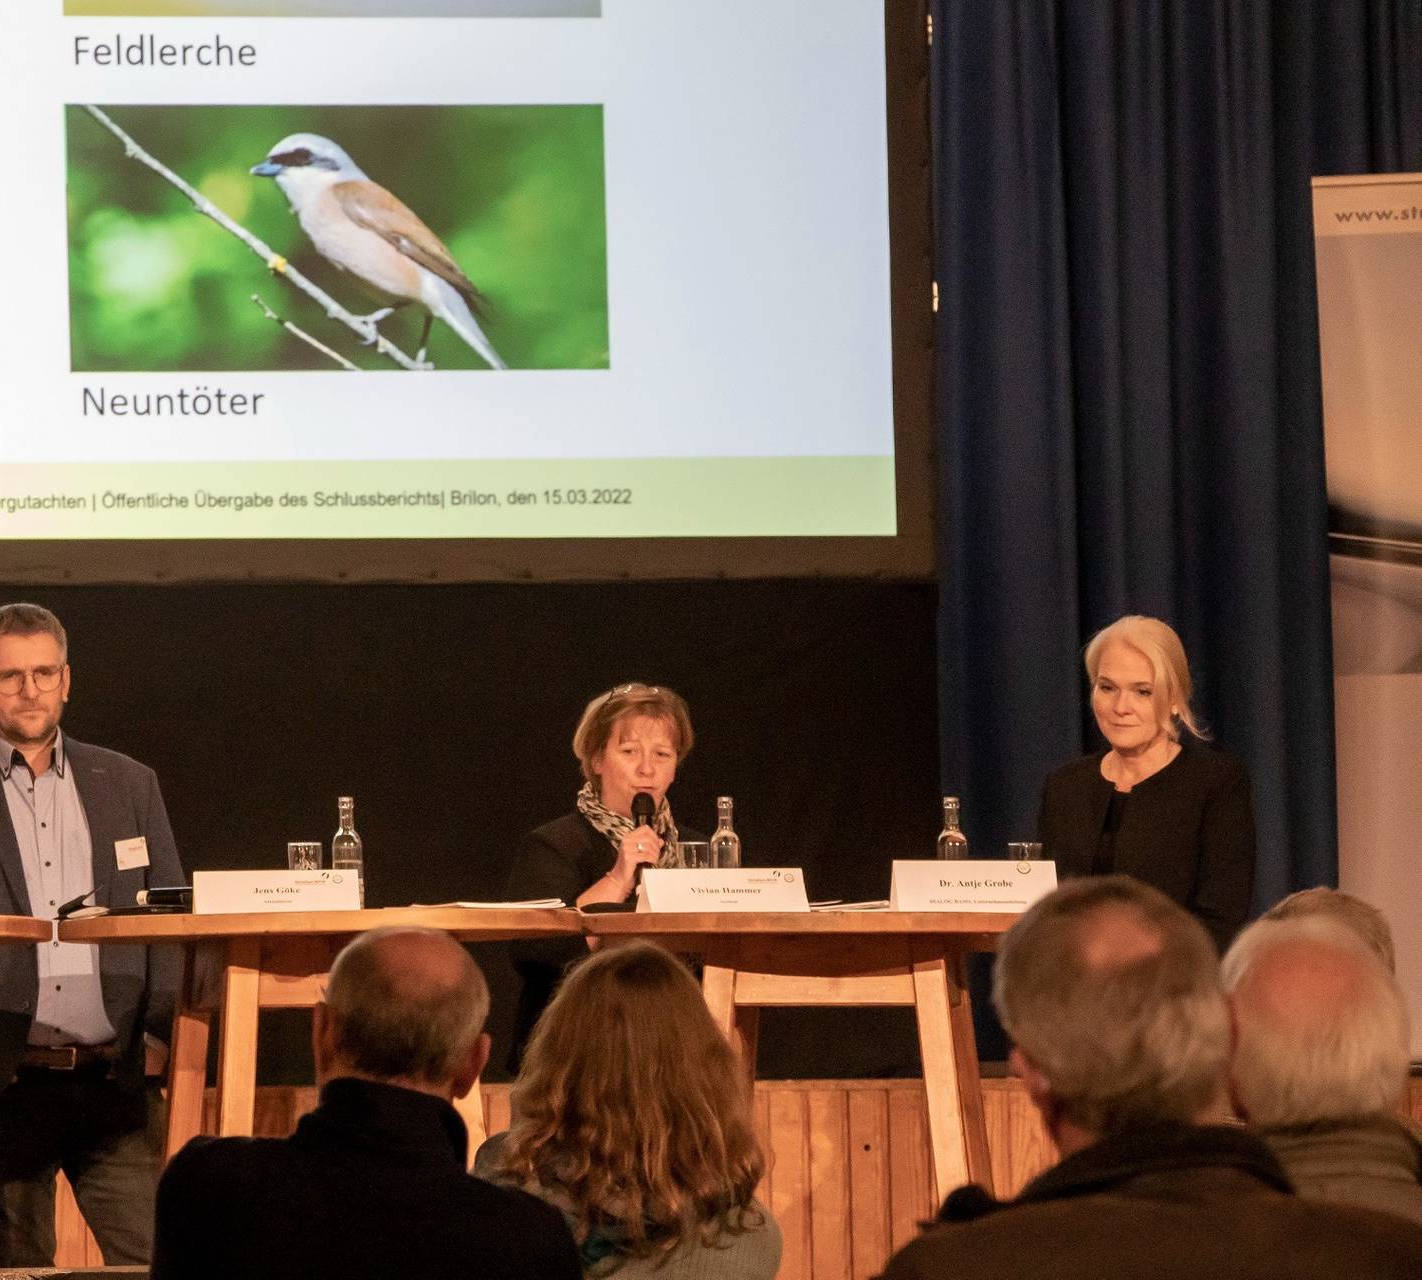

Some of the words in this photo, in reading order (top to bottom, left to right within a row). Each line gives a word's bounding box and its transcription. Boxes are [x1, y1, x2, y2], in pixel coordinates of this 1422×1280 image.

[74, 33, 257, 67] Feldlerche
[82, 386, 265, 416] Neuntöter
[101, 490, 190, 509] Öffentliche
[194, 489, 275, 512] Übergabe
[278, 492, 309, 508] des
[450, 489, 502, 509] Brilon,
[506, 490, 538, 506] den
[543, 488, 633, 505] 15.03.2022
[939, 879, 954, 888] Dr.
[957, 879, 982, 889] Antje
[984, 879, 1014, 888] Grobe
